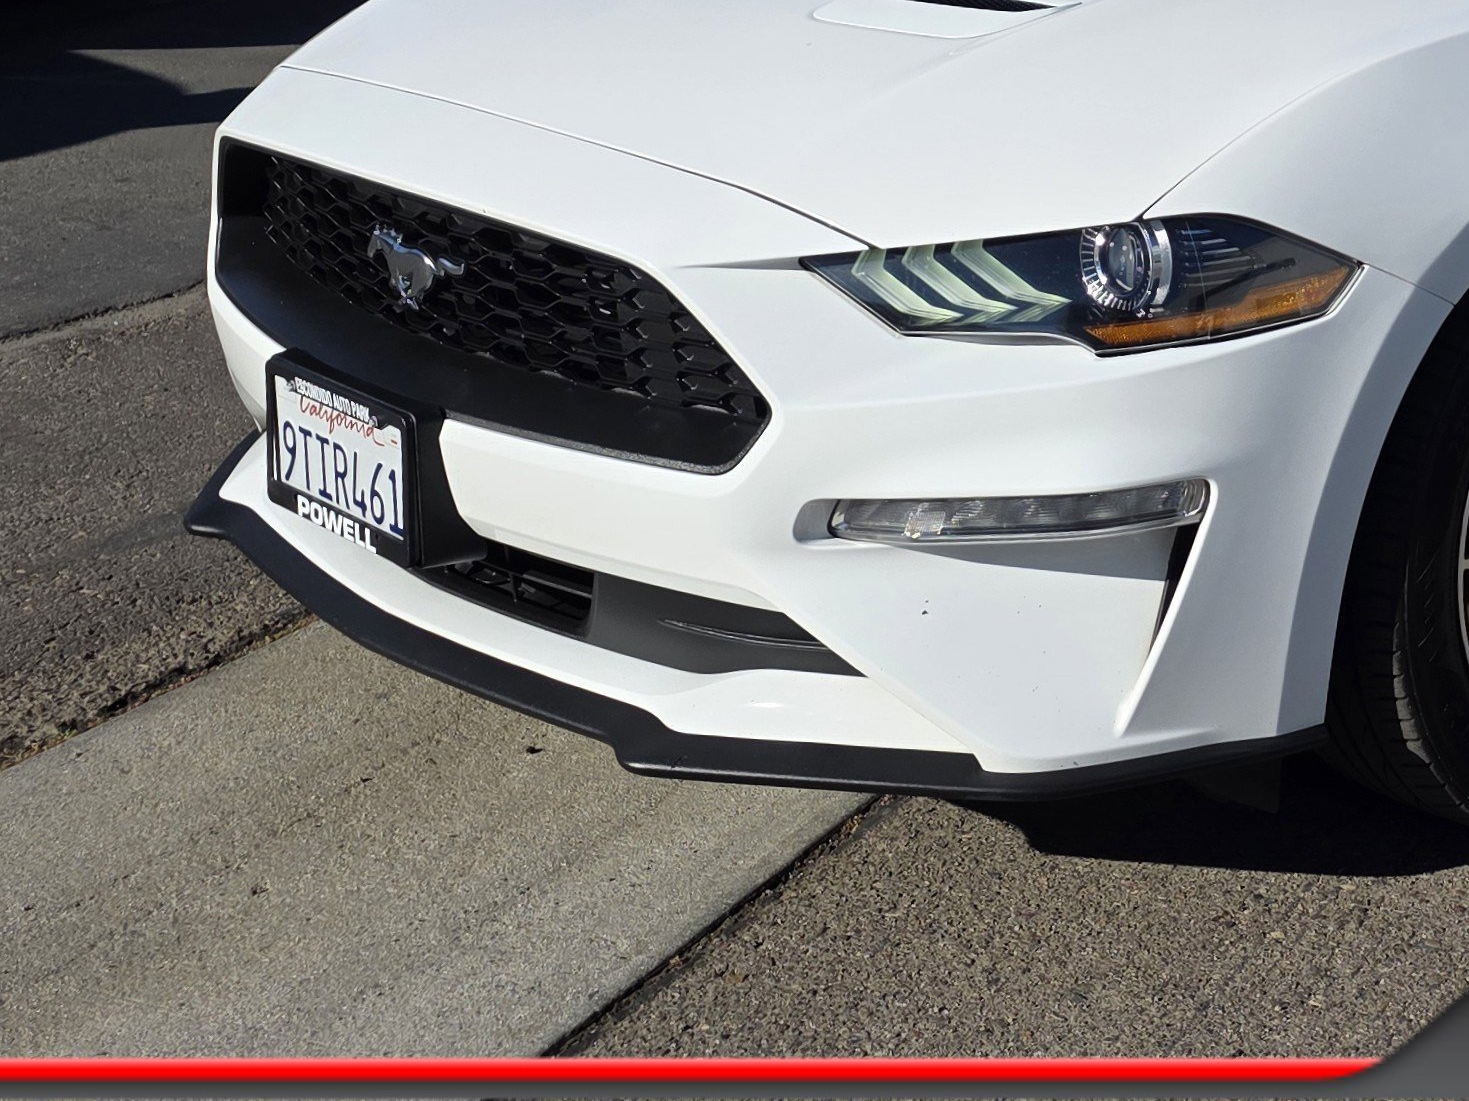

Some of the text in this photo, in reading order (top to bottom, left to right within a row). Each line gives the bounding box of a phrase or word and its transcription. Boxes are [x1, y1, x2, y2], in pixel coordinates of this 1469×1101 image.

[294, 376, 370, 424] ESCONDIDO AUTO PARK
[282, 419, 404, 536] 9TIR461
[297, 494, 377, 555] POWELL
